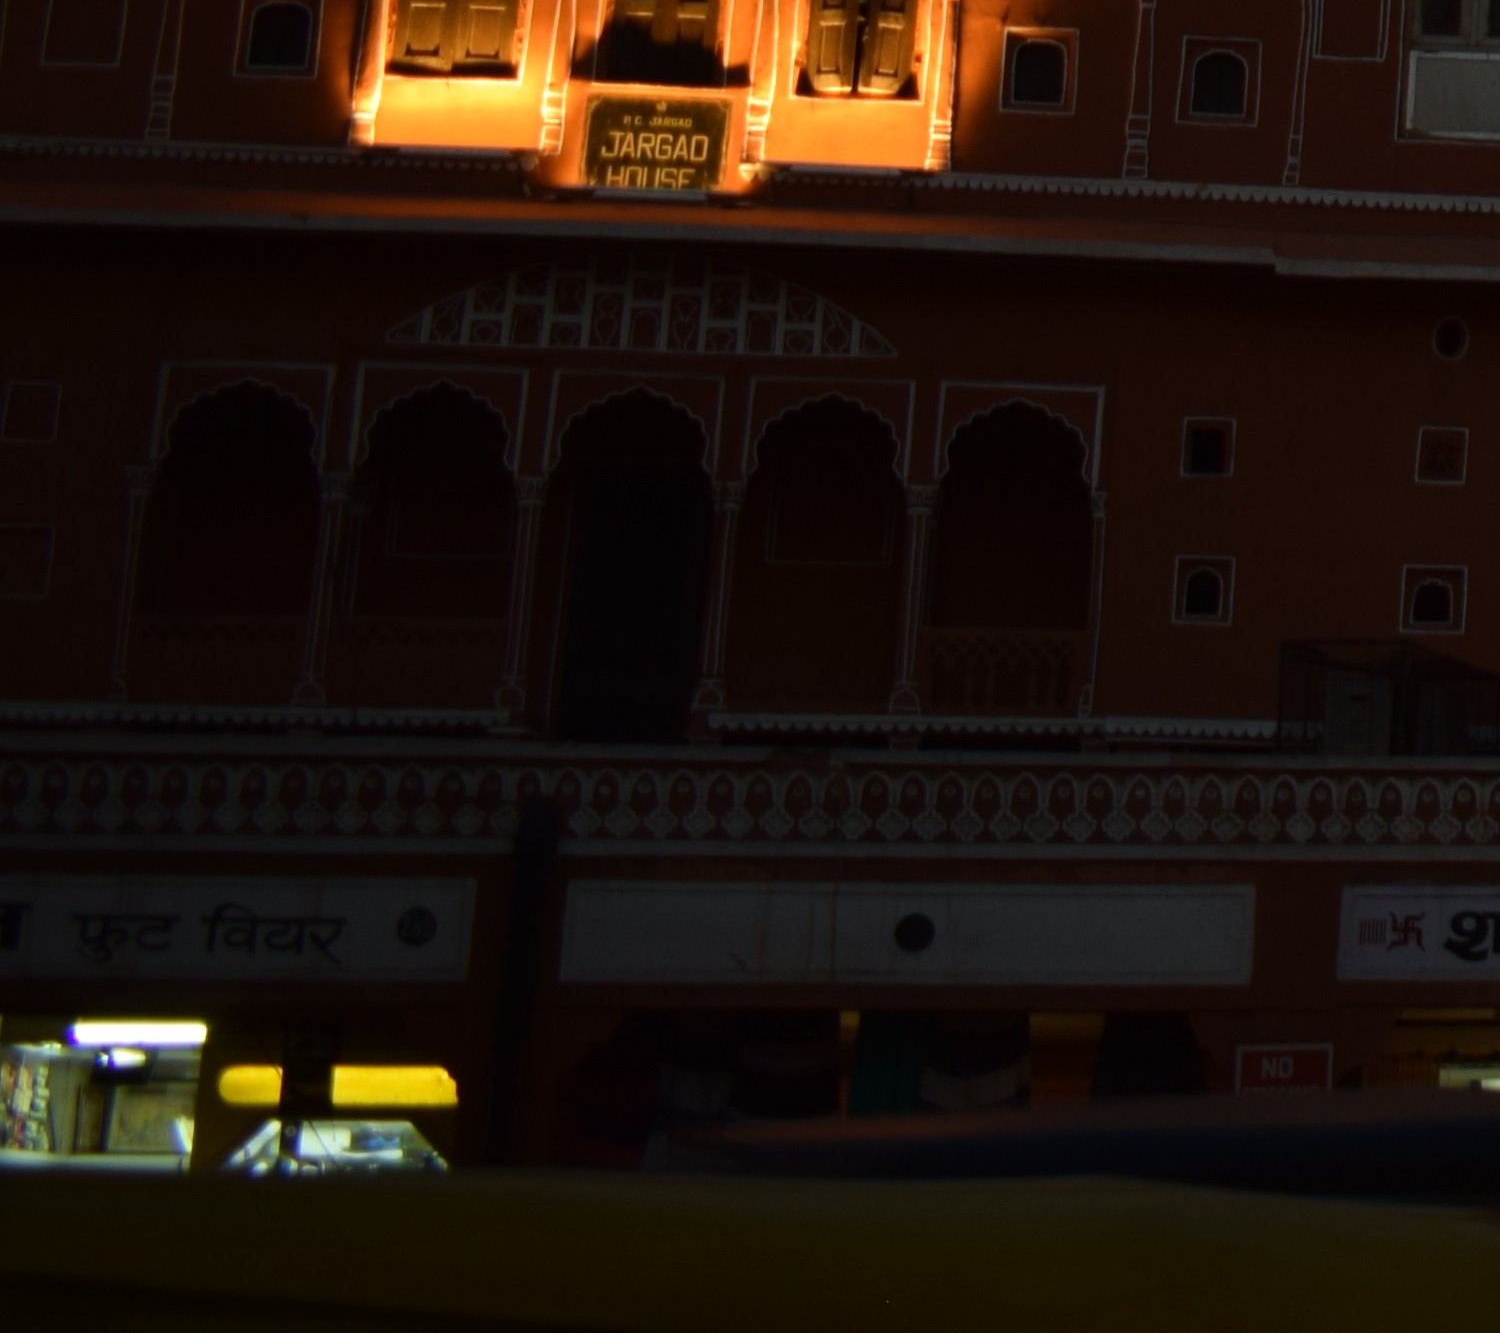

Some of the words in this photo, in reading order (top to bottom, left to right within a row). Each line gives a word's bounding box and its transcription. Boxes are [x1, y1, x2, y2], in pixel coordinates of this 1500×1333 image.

[601, 131, 709, 162] JARGAD
[72, 913, 180, 964] फुट
[202, 901, 347, 965] वियर
[1261, 1056, 1294, 1075] NO
